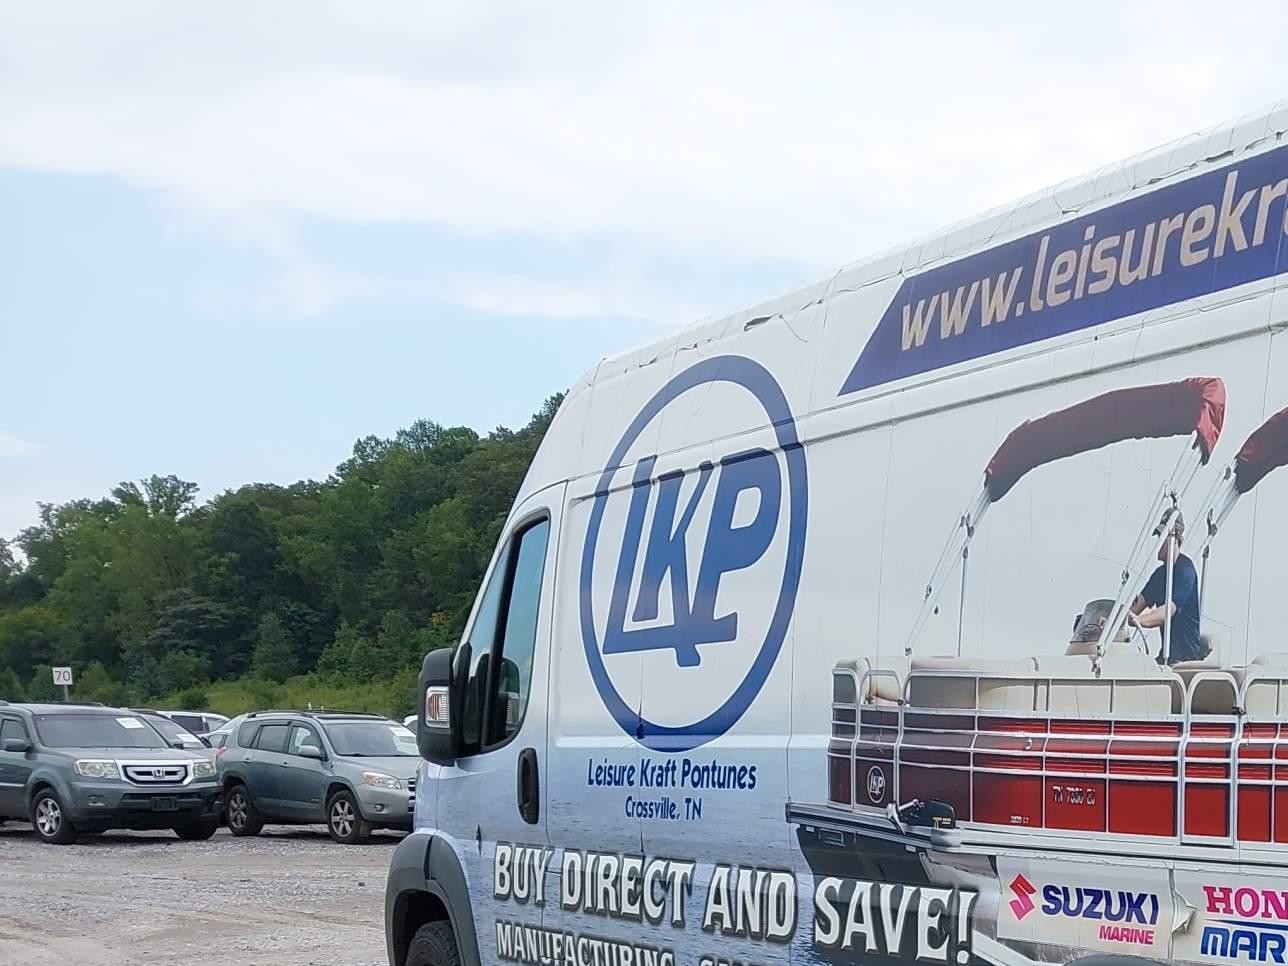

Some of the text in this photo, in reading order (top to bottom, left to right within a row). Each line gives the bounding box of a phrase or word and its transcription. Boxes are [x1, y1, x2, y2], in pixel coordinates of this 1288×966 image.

[602, 447, 782, 667] LKP
[54, 670, 71, 682] 70
[587, 757, 757, 790] Leisure Kraft Pontunes
[625, 795, 703, 820] Crossville, TN
[494, 843, 978, 966] BUY DIRECT AND SAVE!
[1042, 885, 1159, 923] SUZUKI
[1099, 924, 1154, 945] MARINE
